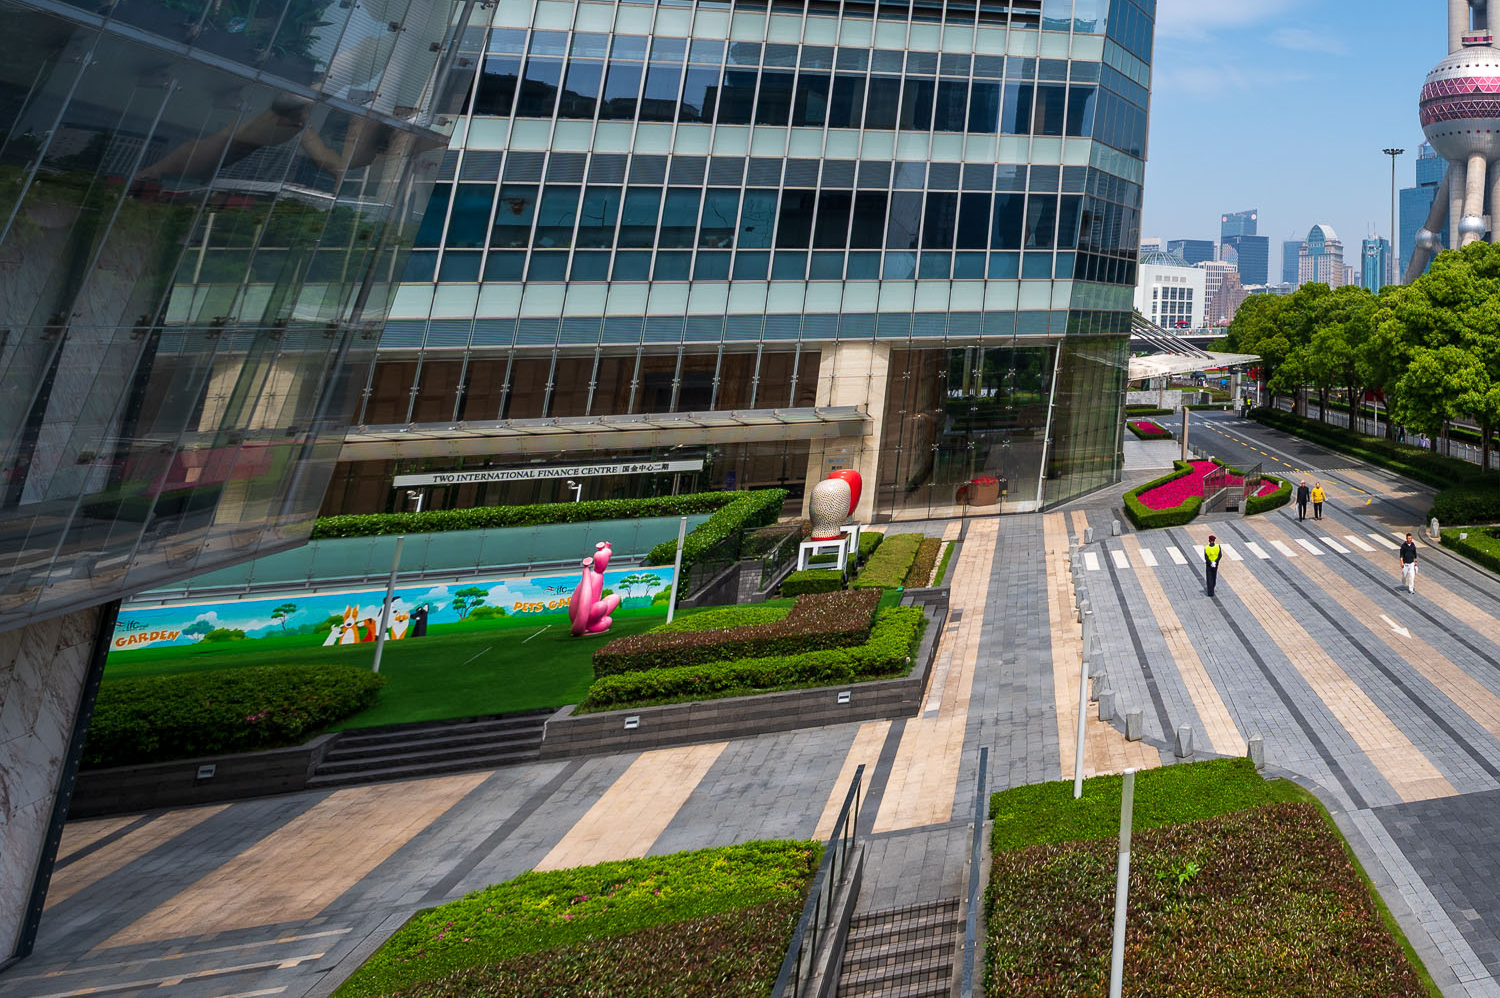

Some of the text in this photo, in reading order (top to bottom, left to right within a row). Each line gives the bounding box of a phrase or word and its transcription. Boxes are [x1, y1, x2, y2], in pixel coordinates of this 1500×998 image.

[432, 463, 670, 484] TWO INTERNATIONAL FINANCE CENTRE 国金中心二期
[513, 602, 543, 612] PETS
[115, 630, 180, 647] GARDEN
